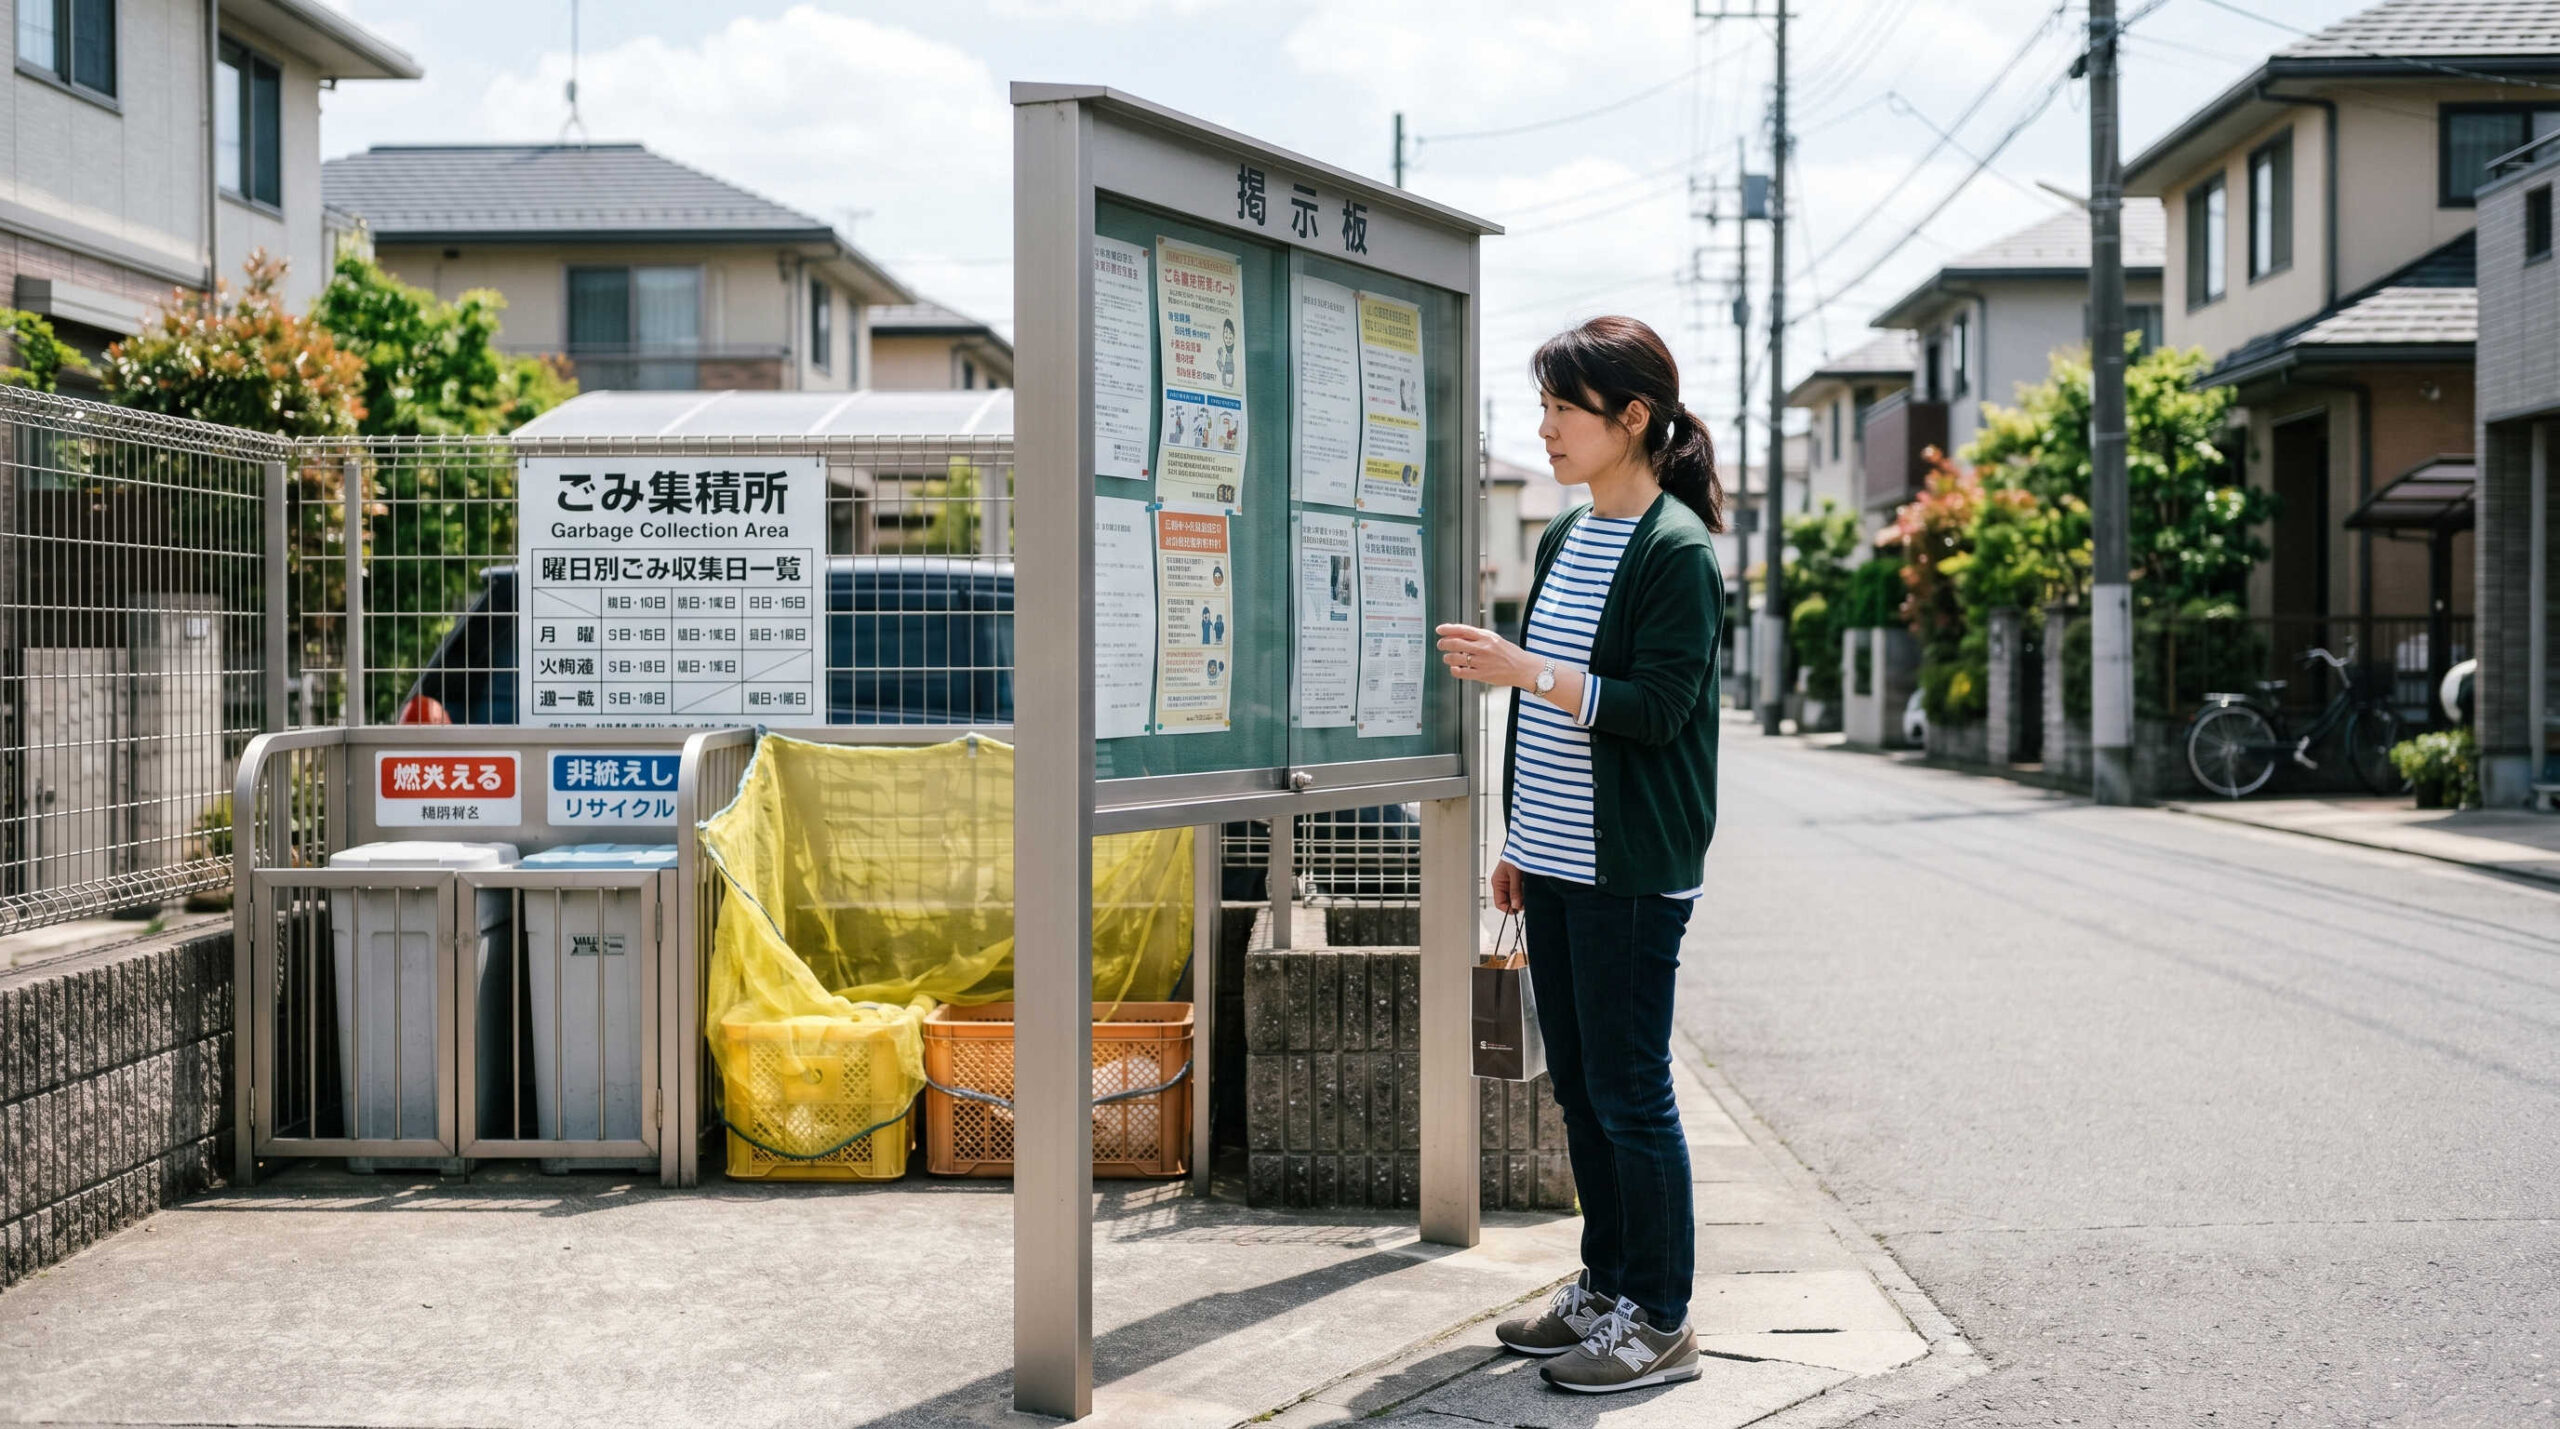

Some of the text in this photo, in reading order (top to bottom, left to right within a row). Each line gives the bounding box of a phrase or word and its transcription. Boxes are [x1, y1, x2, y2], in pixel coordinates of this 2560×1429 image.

[1237, 163, 1368, 255] 掲示板
[557, 470, 788, 515] ごみ集積所
[551, 522, 789, 542] Garbage Collection Area
[542, 556, 801, 581] 曜日別ごみ収集日一覧
[566, 798, 675, 818] リサイクル
[1613, 1336, 1658, 1373] N
